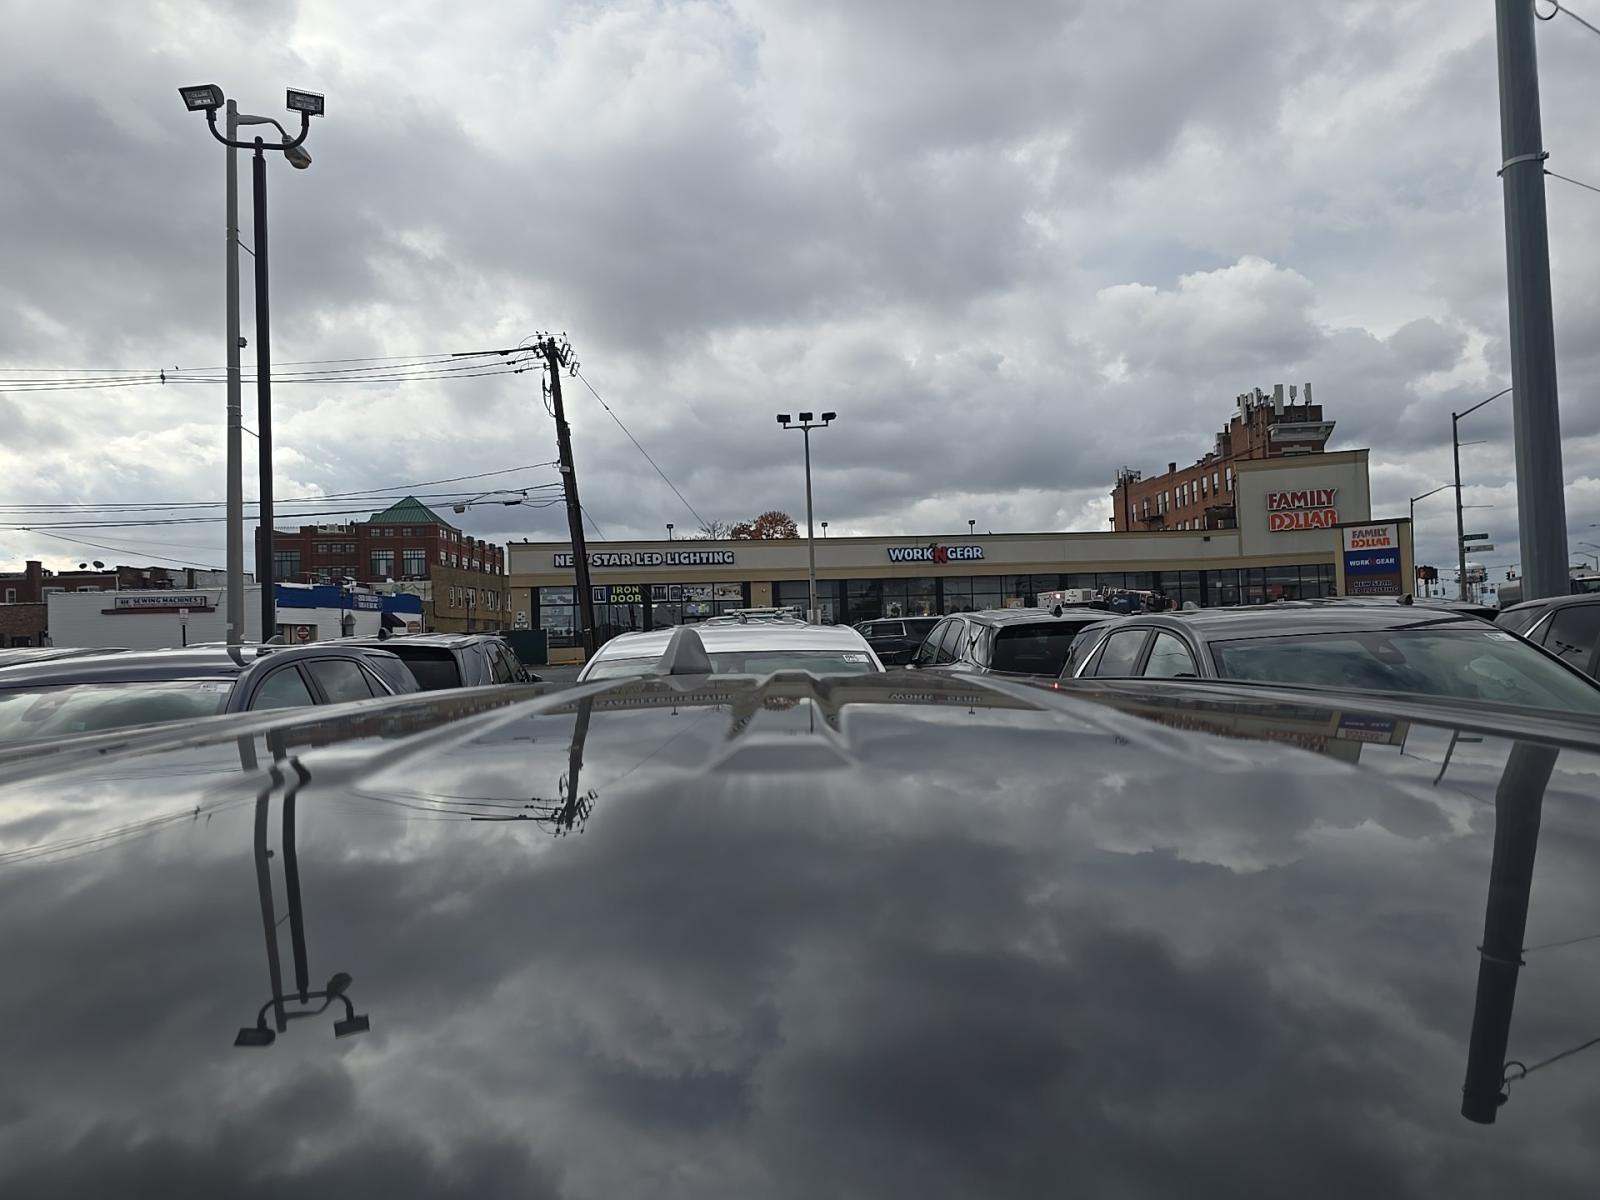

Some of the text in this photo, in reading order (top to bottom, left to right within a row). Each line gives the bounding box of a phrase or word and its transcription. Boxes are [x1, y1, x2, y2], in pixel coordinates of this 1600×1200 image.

[1266, 488, 1337, 511] FAMILY
[1269, 509, 1338, 532] DOLLAR
[1351, 528, 1388, 539] FAMILY
[1351, 538, 1391, 549] DOLLAR
[554, 550, 735, 568] NE STAR LED LIGHTING
[888, 547, 934, 562] WORK
[946, 546, 984, 560] GEAR
[1349, 559, 1370, 567] WORK
[612, 585, 639, 594] IRON
[610, 594, 642, 603] DOOR
